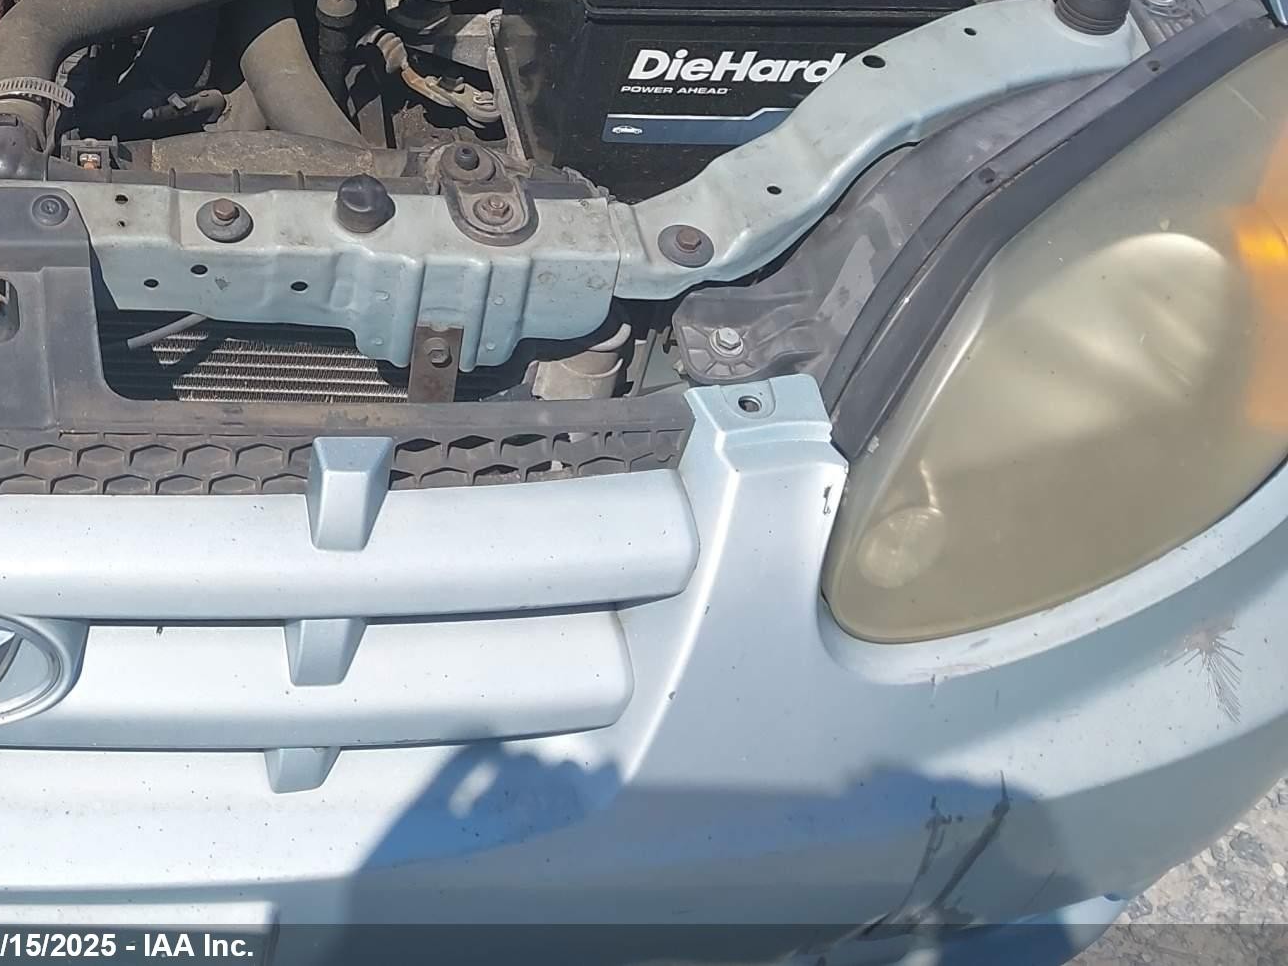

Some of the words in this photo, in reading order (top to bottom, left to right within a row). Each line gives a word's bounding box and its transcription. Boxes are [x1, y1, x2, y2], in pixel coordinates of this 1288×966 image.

[628, 49, 846, 83] DieHard
[620, 86, 673, 94] POWER
[677, 87, 729, 95] AHEAD
